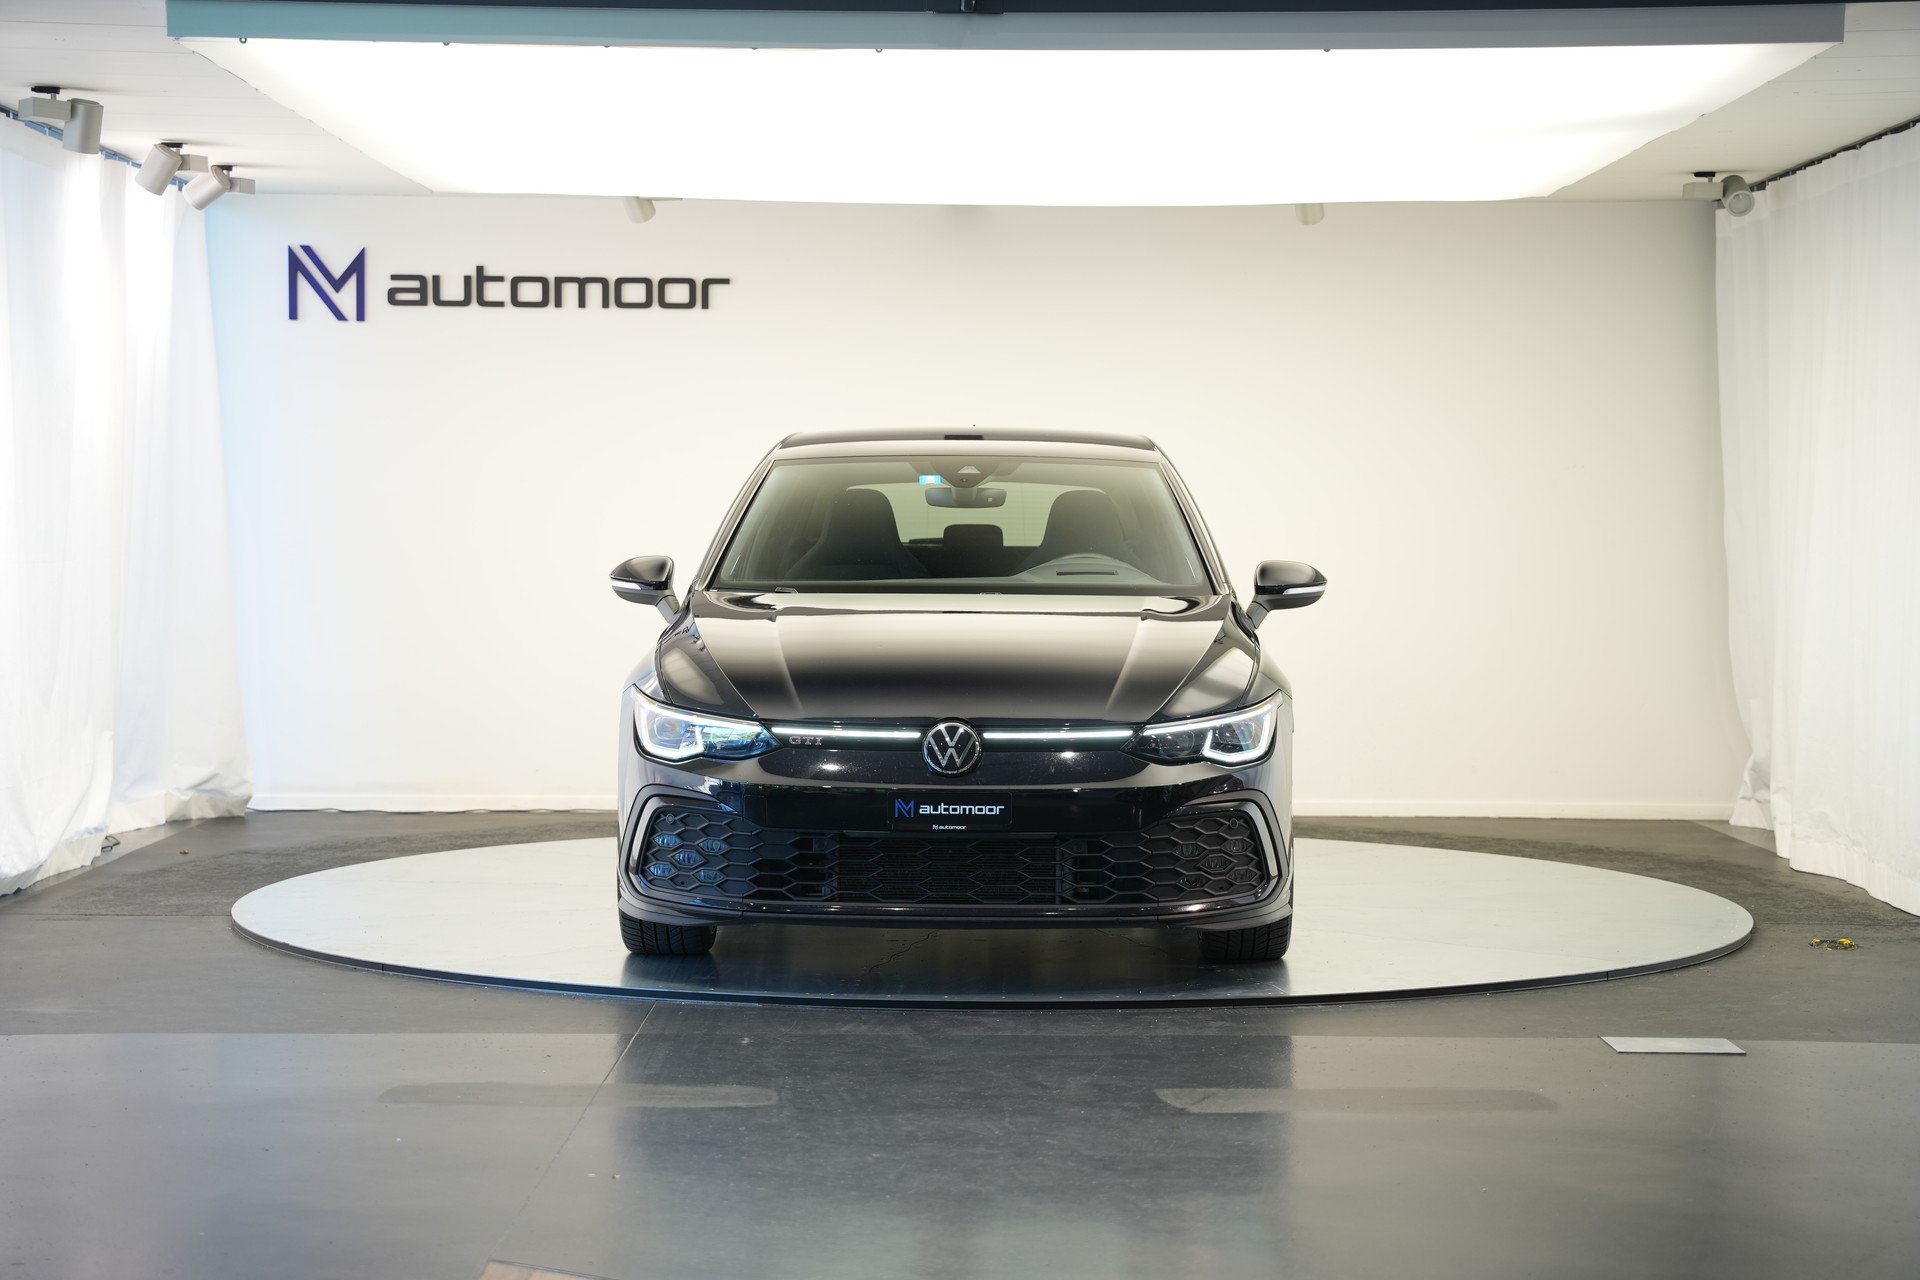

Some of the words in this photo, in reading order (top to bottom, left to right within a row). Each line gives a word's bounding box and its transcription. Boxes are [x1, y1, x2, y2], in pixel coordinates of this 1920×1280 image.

[387, 265, 731, 310] automoor
[789, 735, 823, 746] GTI
[919, 802, 1005, 815] automoor
